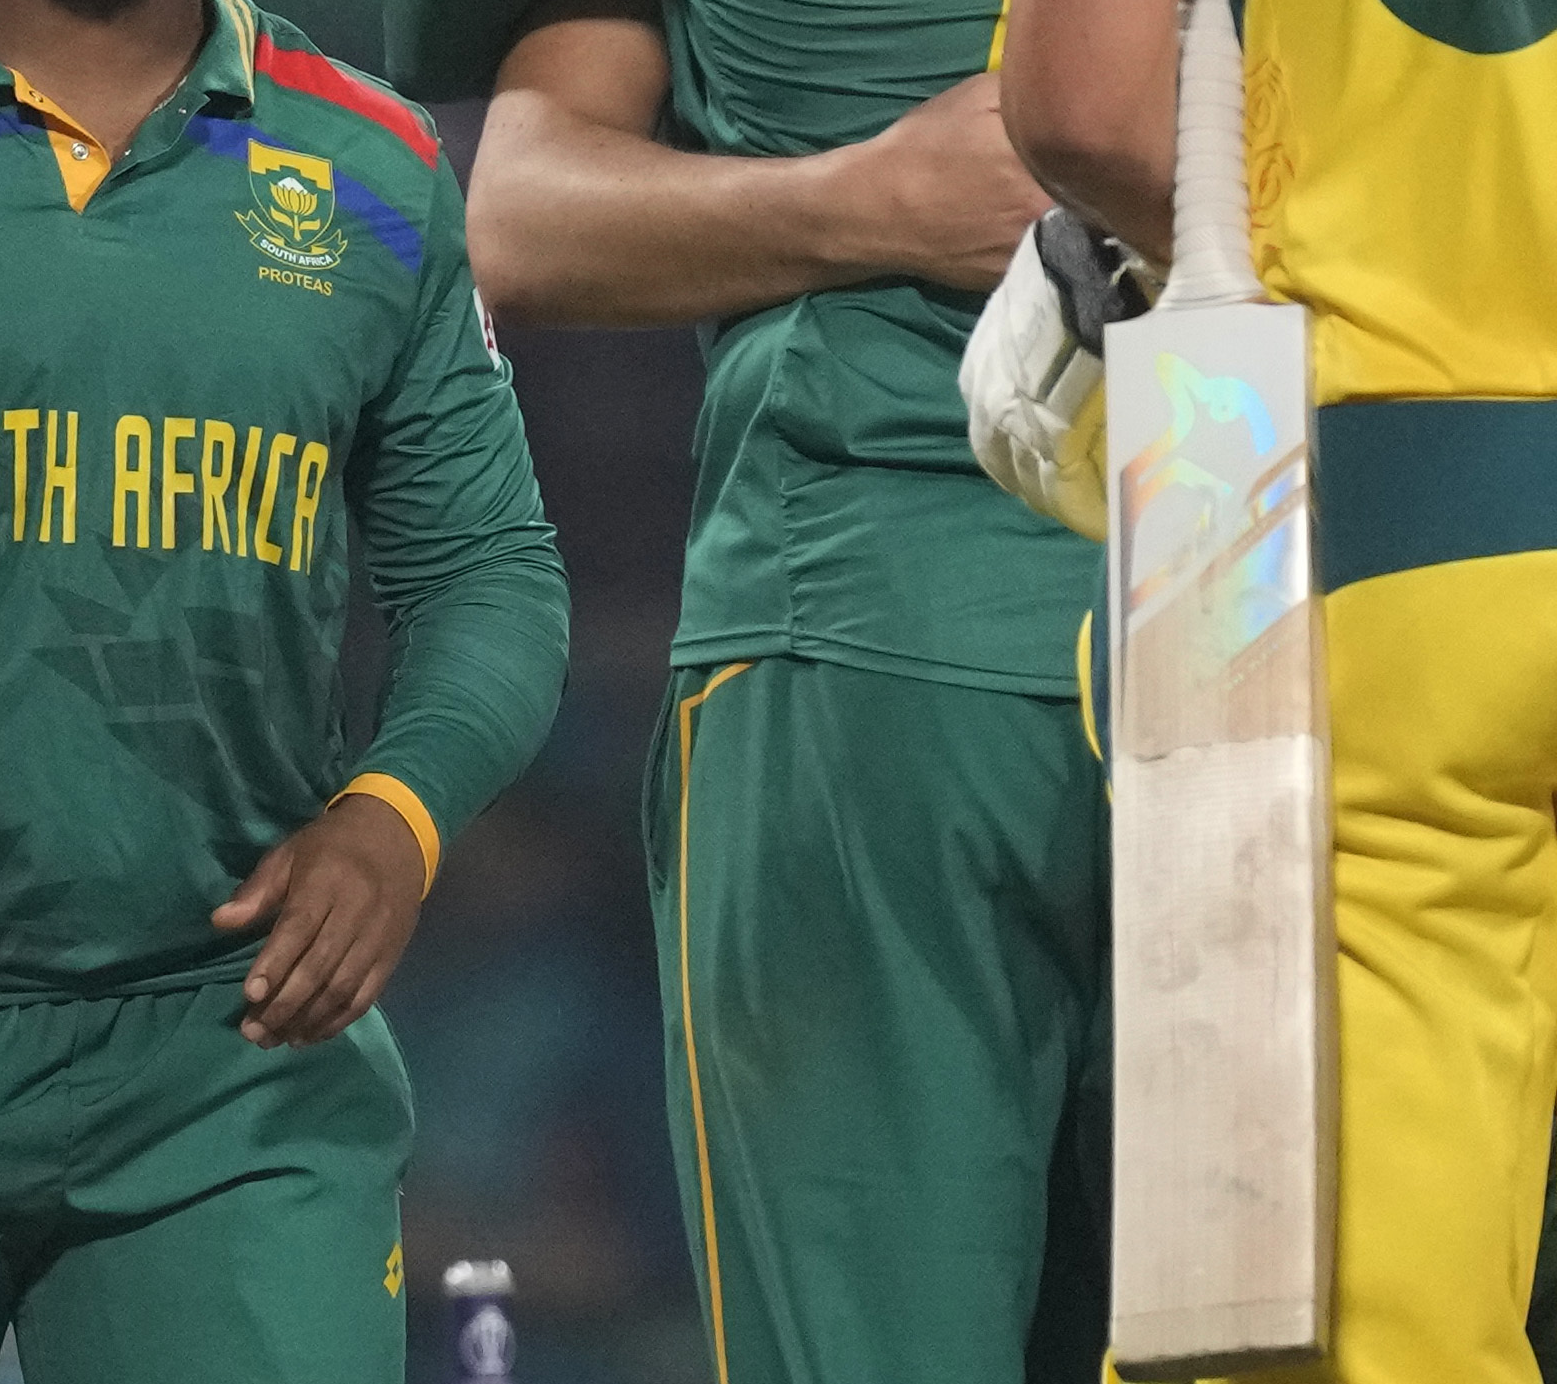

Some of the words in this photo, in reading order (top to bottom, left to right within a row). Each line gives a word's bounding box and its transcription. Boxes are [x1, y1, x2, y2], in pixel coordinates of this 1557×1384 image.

[259, 238, 297, 263] SOUTH
[298, 254, 334, 267] AFRICA
[258, 266, 333, 296] PROTEAS
[111, 416, 328, 575] AFRICA
